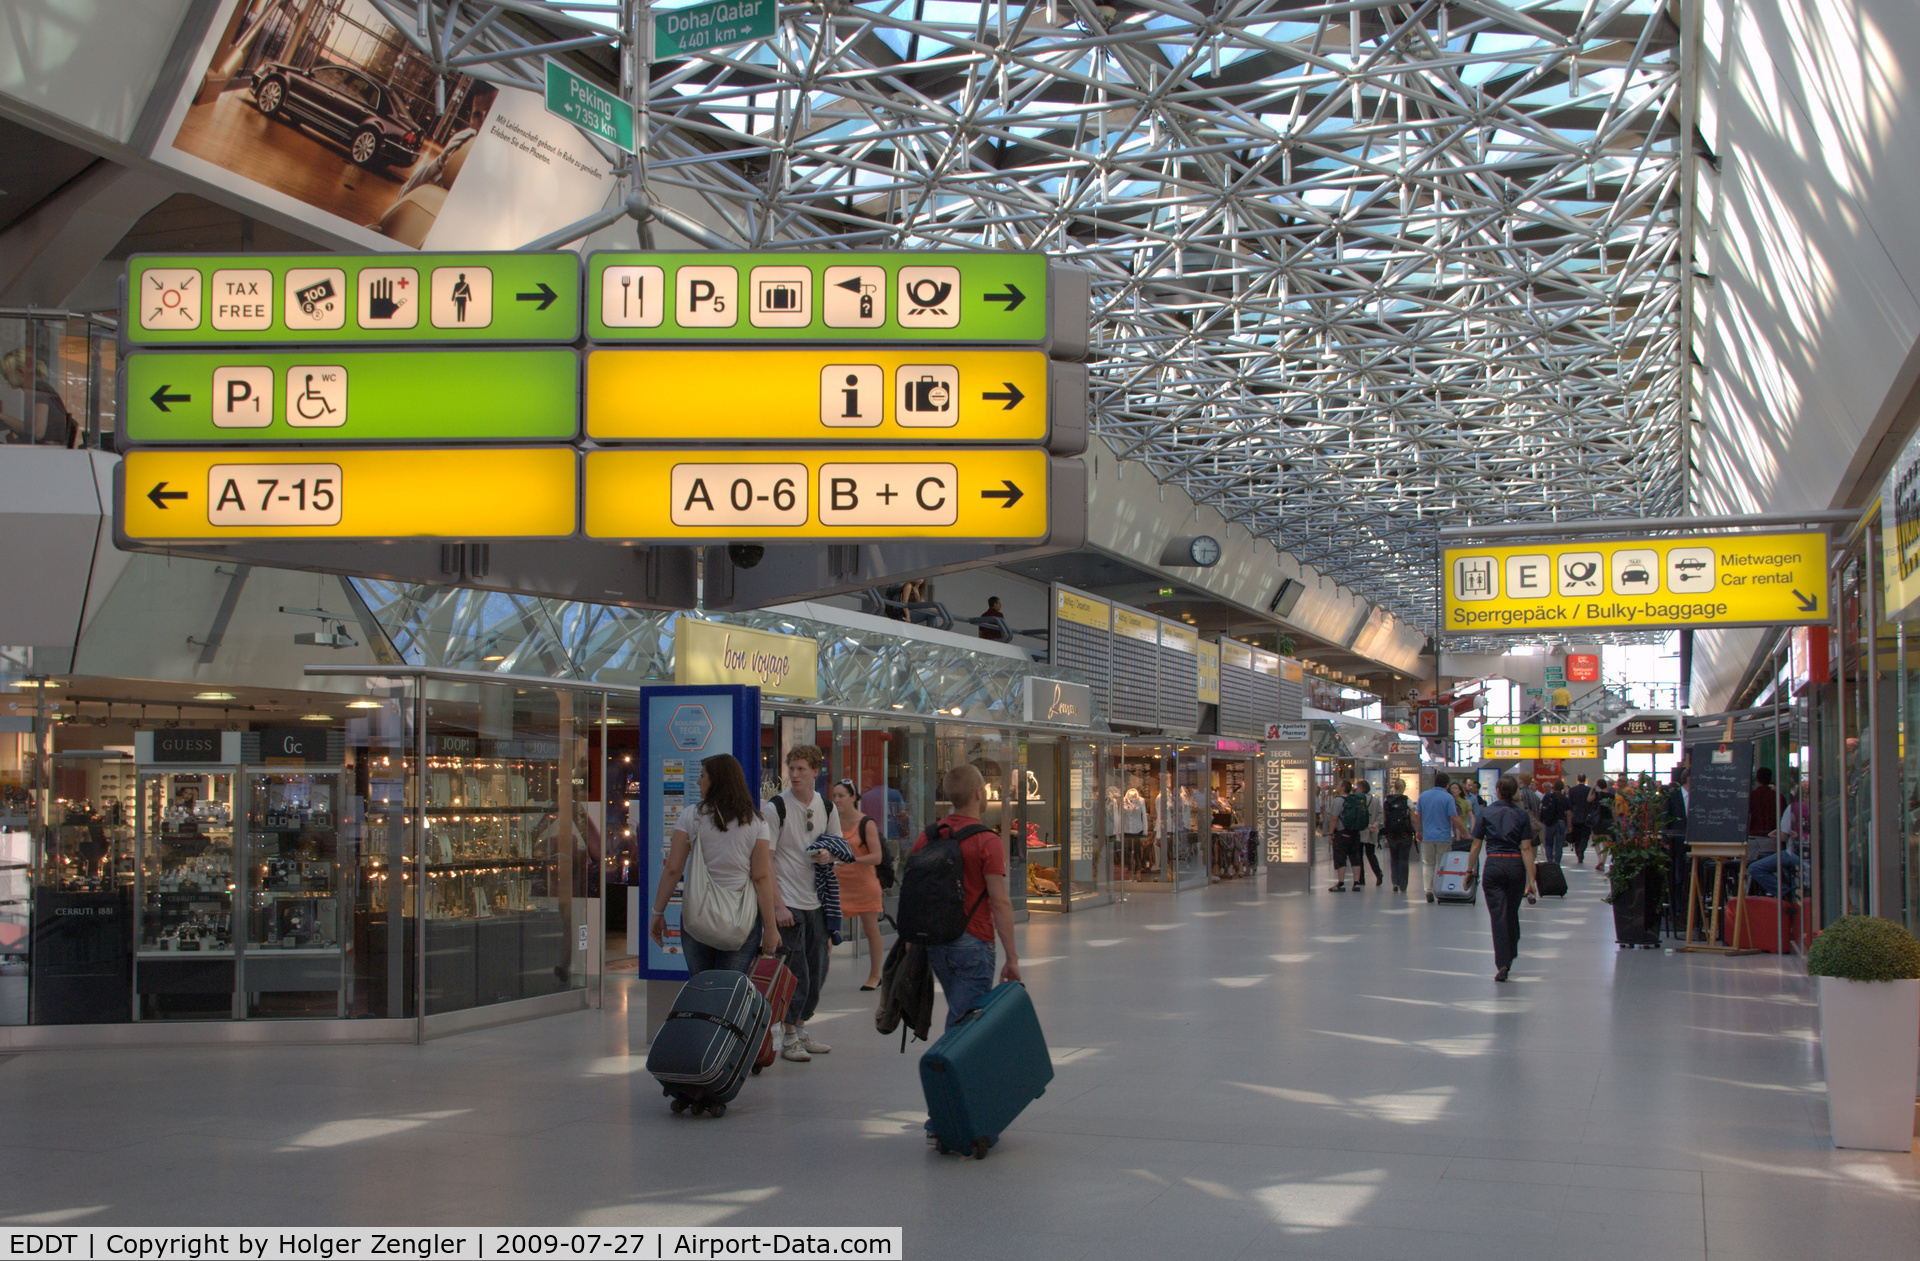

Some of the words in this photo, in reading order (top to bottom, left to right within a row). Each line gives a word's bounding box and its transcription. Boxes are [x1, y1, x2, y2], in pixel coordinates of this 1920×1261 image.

[667, 1, 763, 34] Doha/Qatar
[715, 28, 737, 42] km
[570, 78, 612, 120] Peking
[601, 118, 617, 139] km
[490, 126, 510, 142] Erleben
[510, 137, 519, 147] Sie
[519, 141, 530, 152] den
[496, 114, 506, 125] Mit
[506, 119, 539, 143] Leidenschaft
[562, 151, 575, 165] Ruhe
[574, 159, 581, 167] zu
[226, 282, 259, 295] TAX
[304, 286, 326, 301] 100
[219, 305, 265, 318] FREE
[321, 373, 337, 382] WC
[216, 478, 246, 511] A
[257, 479, 334, 511] 7-15
[684, 478, 715, 511] A
[730, 478, 796, 512] 0-6
[831, 478, 859, 511] B
[876, 483, 899, 505] +
[915, 476, 946, 512] C
[1721, 552, 1802, 567] Mietwagen
[1519, 565, 1538, 588] E
[1721, 574, 1747, 586] Car
[1752, 571, 1793, 585] rental
[1453, 605, 1567, 626] Sperrgepäck
[1572, 604, 1580, 619] /
[1587, 602, 1727, 621] Bulky-baggage
[723, 633, 746, 670] bon
[751, 651, 789, 687] voyage
[679, 727, 702, 735] TEGEL
[162, 739, 213, 750] GUESS
[284, 736, 302, 754] Gc
[442, 738, 469, 751] JOOP!
[1267, 760, 1279, 862] SERVICECENTER
[709, 1016, 730, 1027] IMEX
